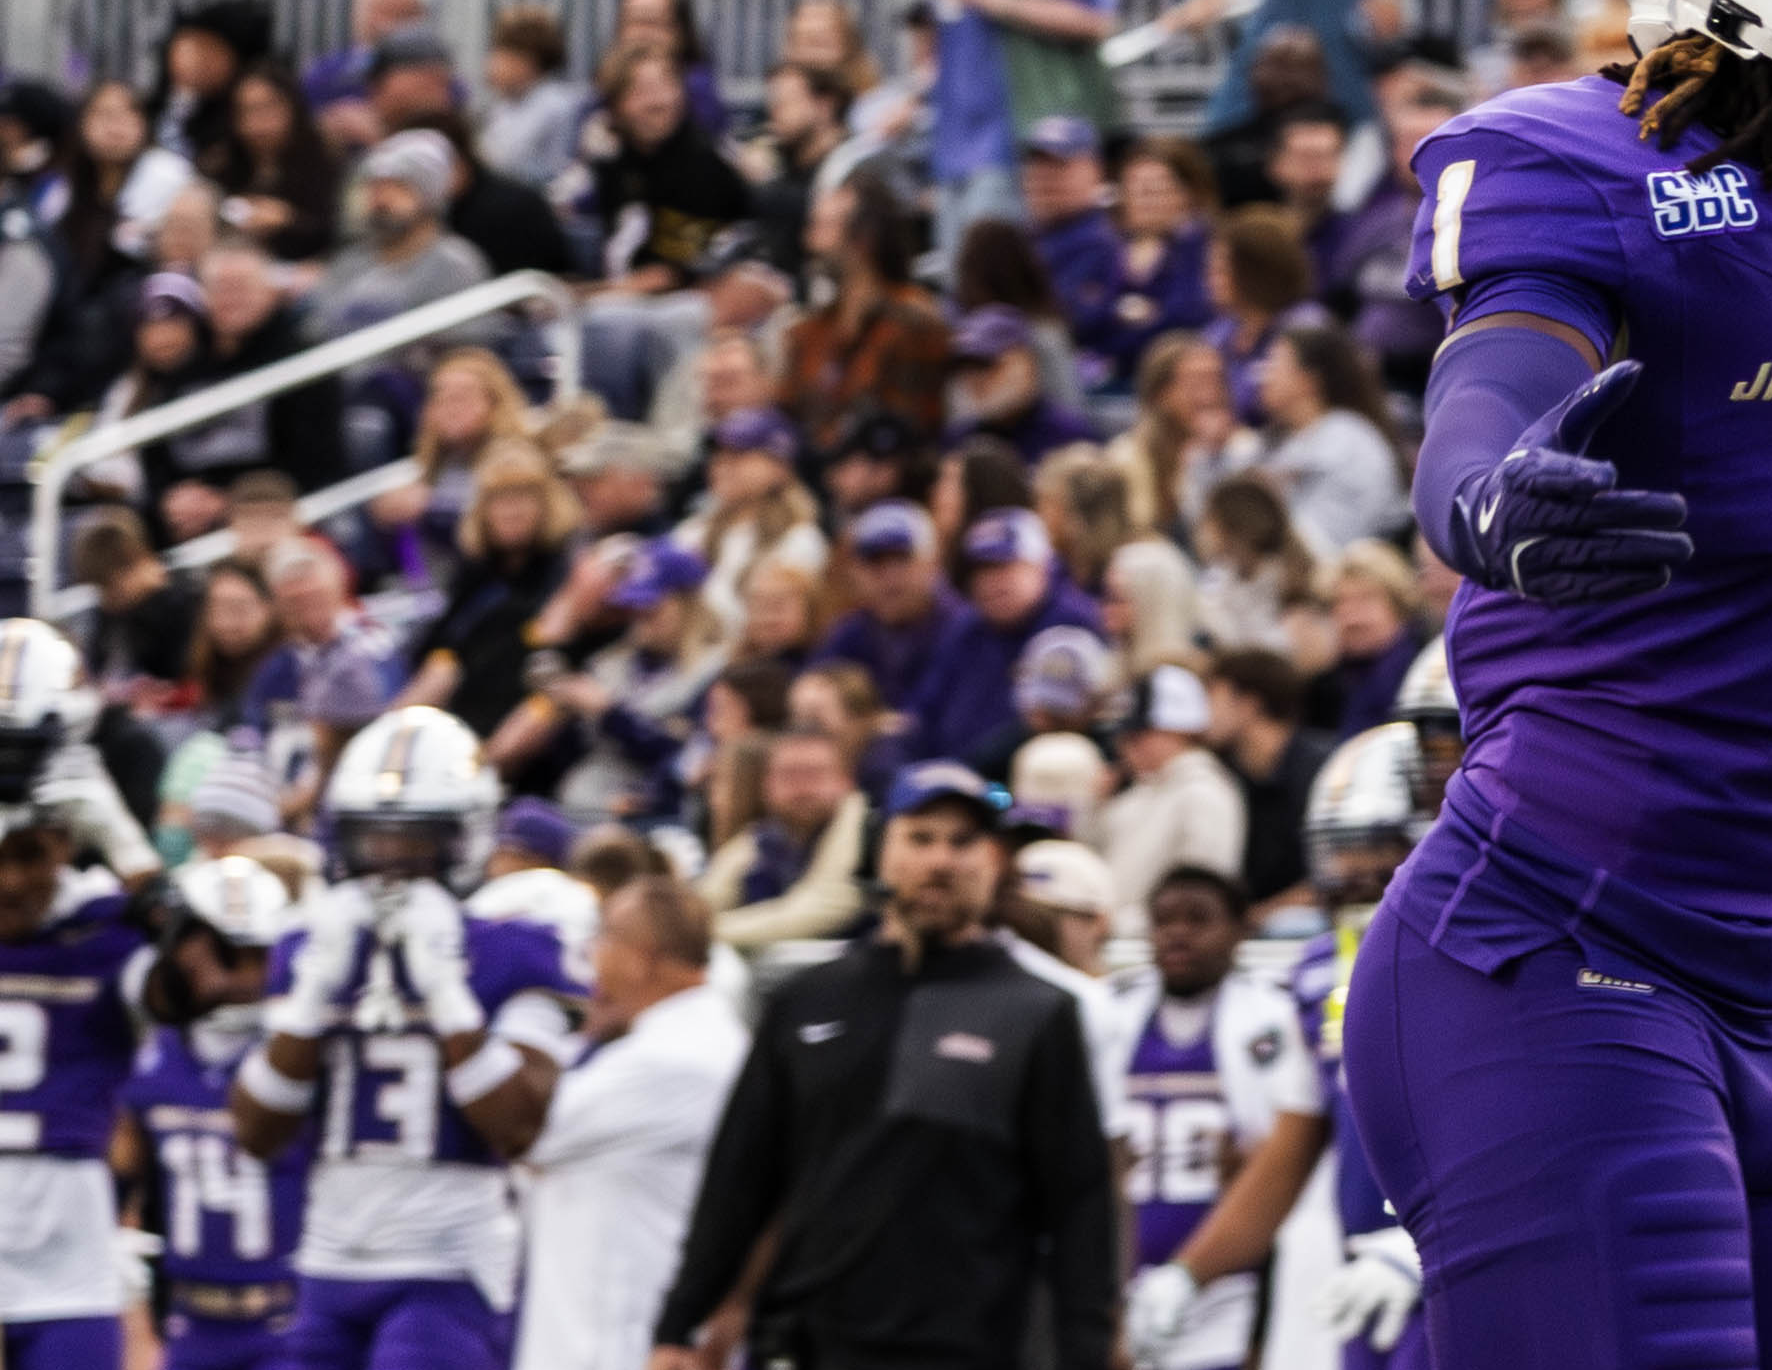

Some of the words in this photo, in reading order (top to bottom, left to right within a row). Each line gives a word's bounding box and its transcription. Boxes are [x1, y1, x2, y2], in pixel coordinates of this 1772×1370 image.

[1431, 160, 1476, 291] 1
[1647, 164, 1758, 236] SBC
[320, 1033, 434, 1164] 13
[160, 1132, 274, 1257] 14
